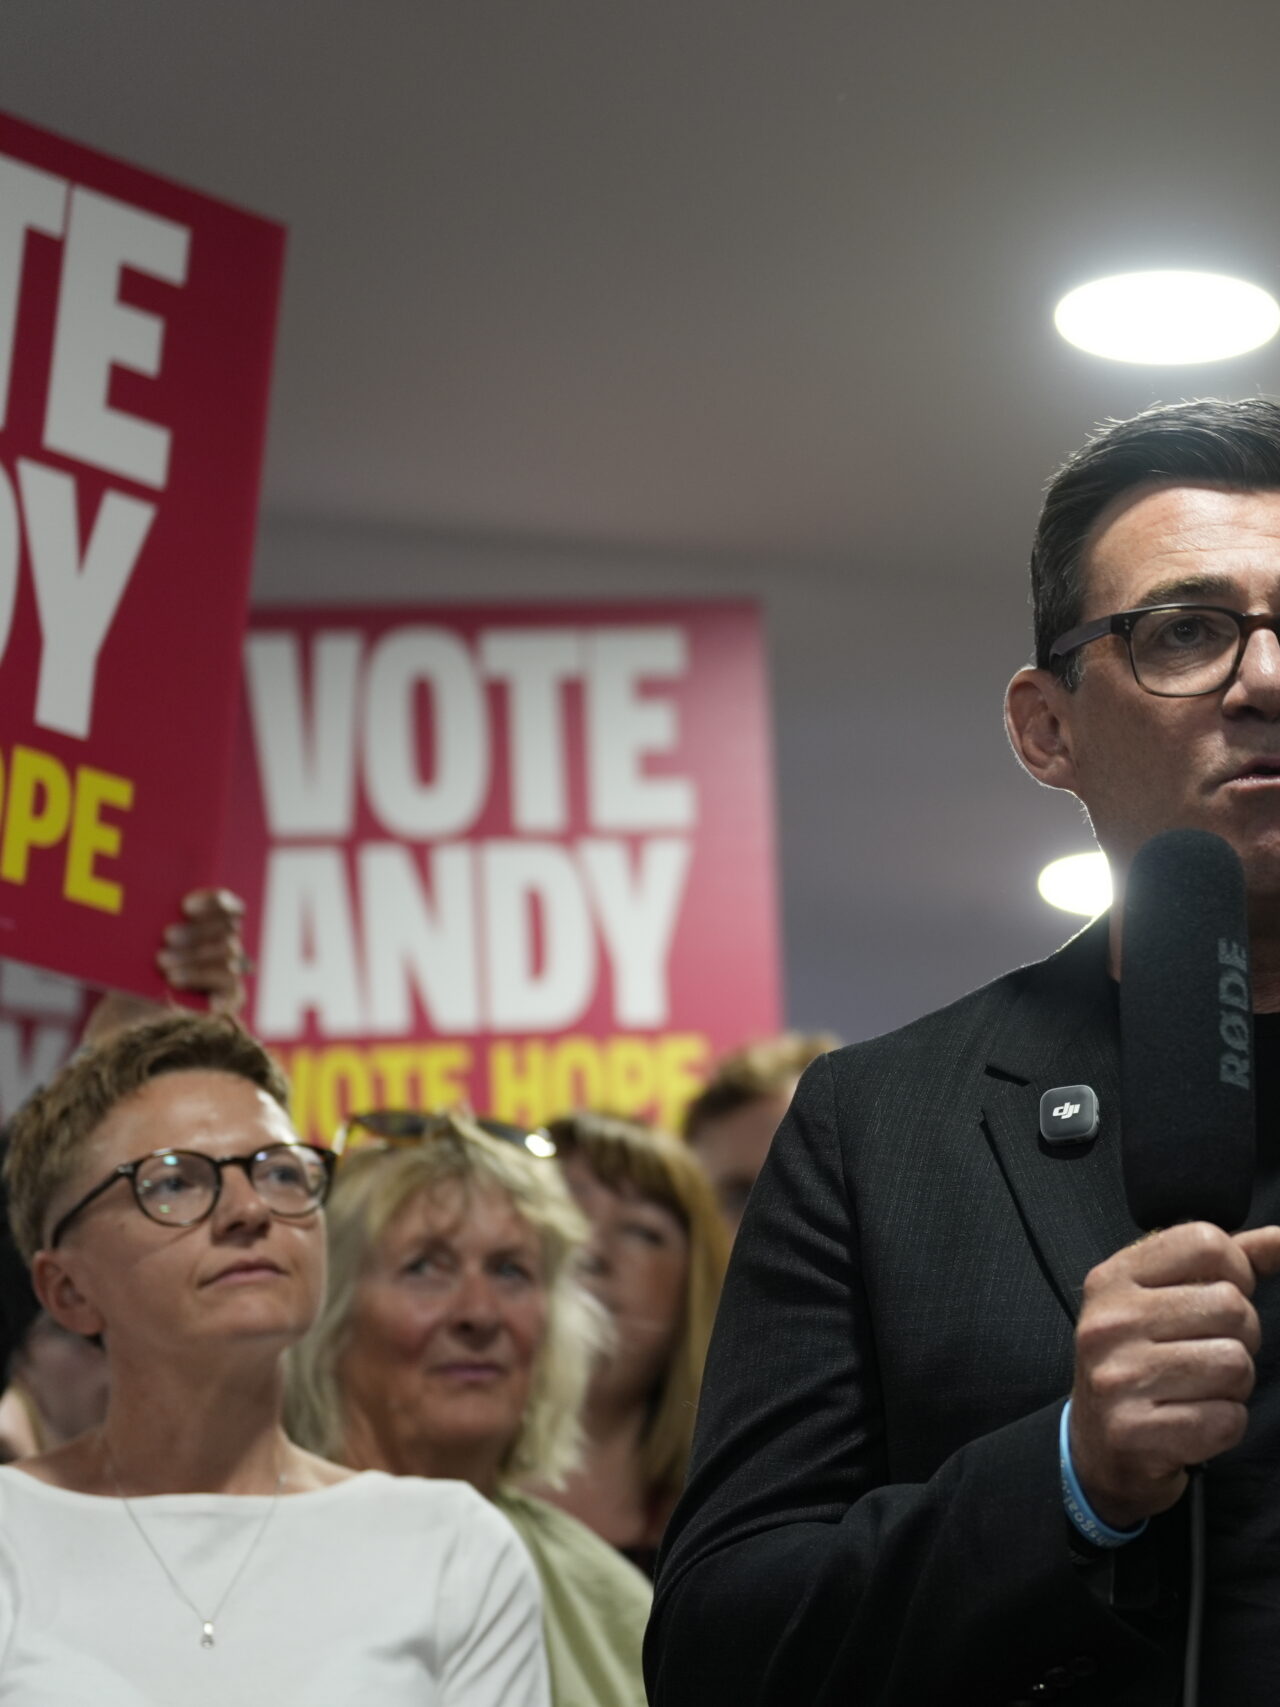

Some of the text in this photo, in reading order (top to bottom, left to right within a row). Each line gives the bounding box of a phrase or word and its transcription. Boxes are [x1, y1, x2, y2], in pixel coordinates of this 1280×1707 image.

[0, 450, 156, 741] Y
[0, 744, 134, 914] PE
[244, 627, 696, 838] VOTE
[256, 837, 691, 1036] ANDY
